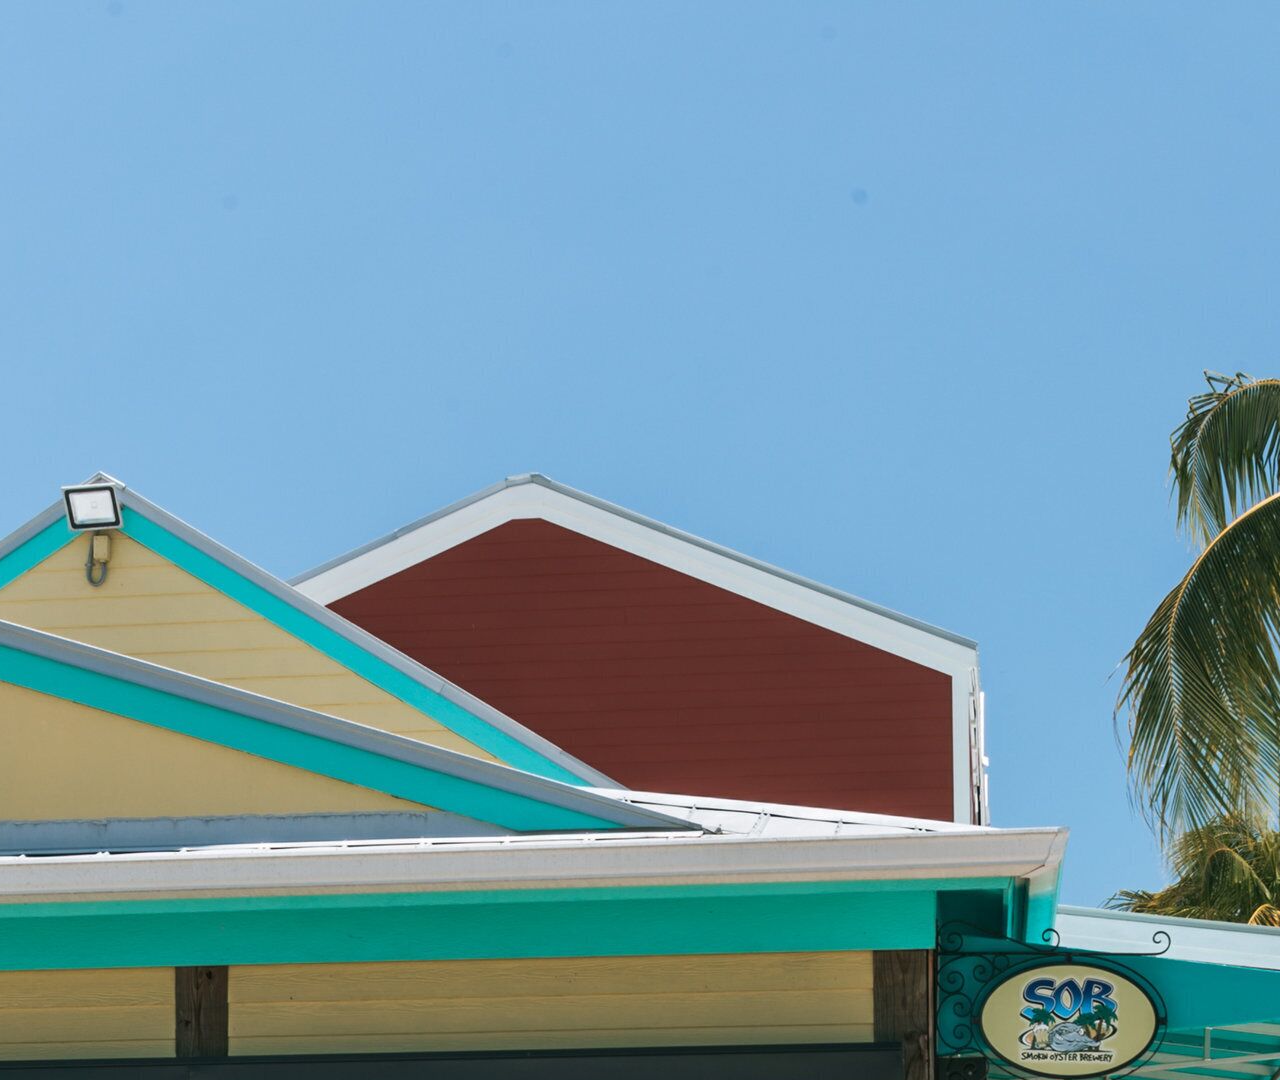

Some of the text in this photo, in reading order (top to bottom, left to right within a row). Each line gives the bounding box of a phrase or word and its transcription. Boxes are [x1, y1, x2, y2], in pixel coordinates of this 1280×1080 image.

[1021, 977, 1118, 1021] SOB
[1050, 1053, 1077, 1062] OYSTER
[1079, 1051, 1113, 1062] BREWERY
